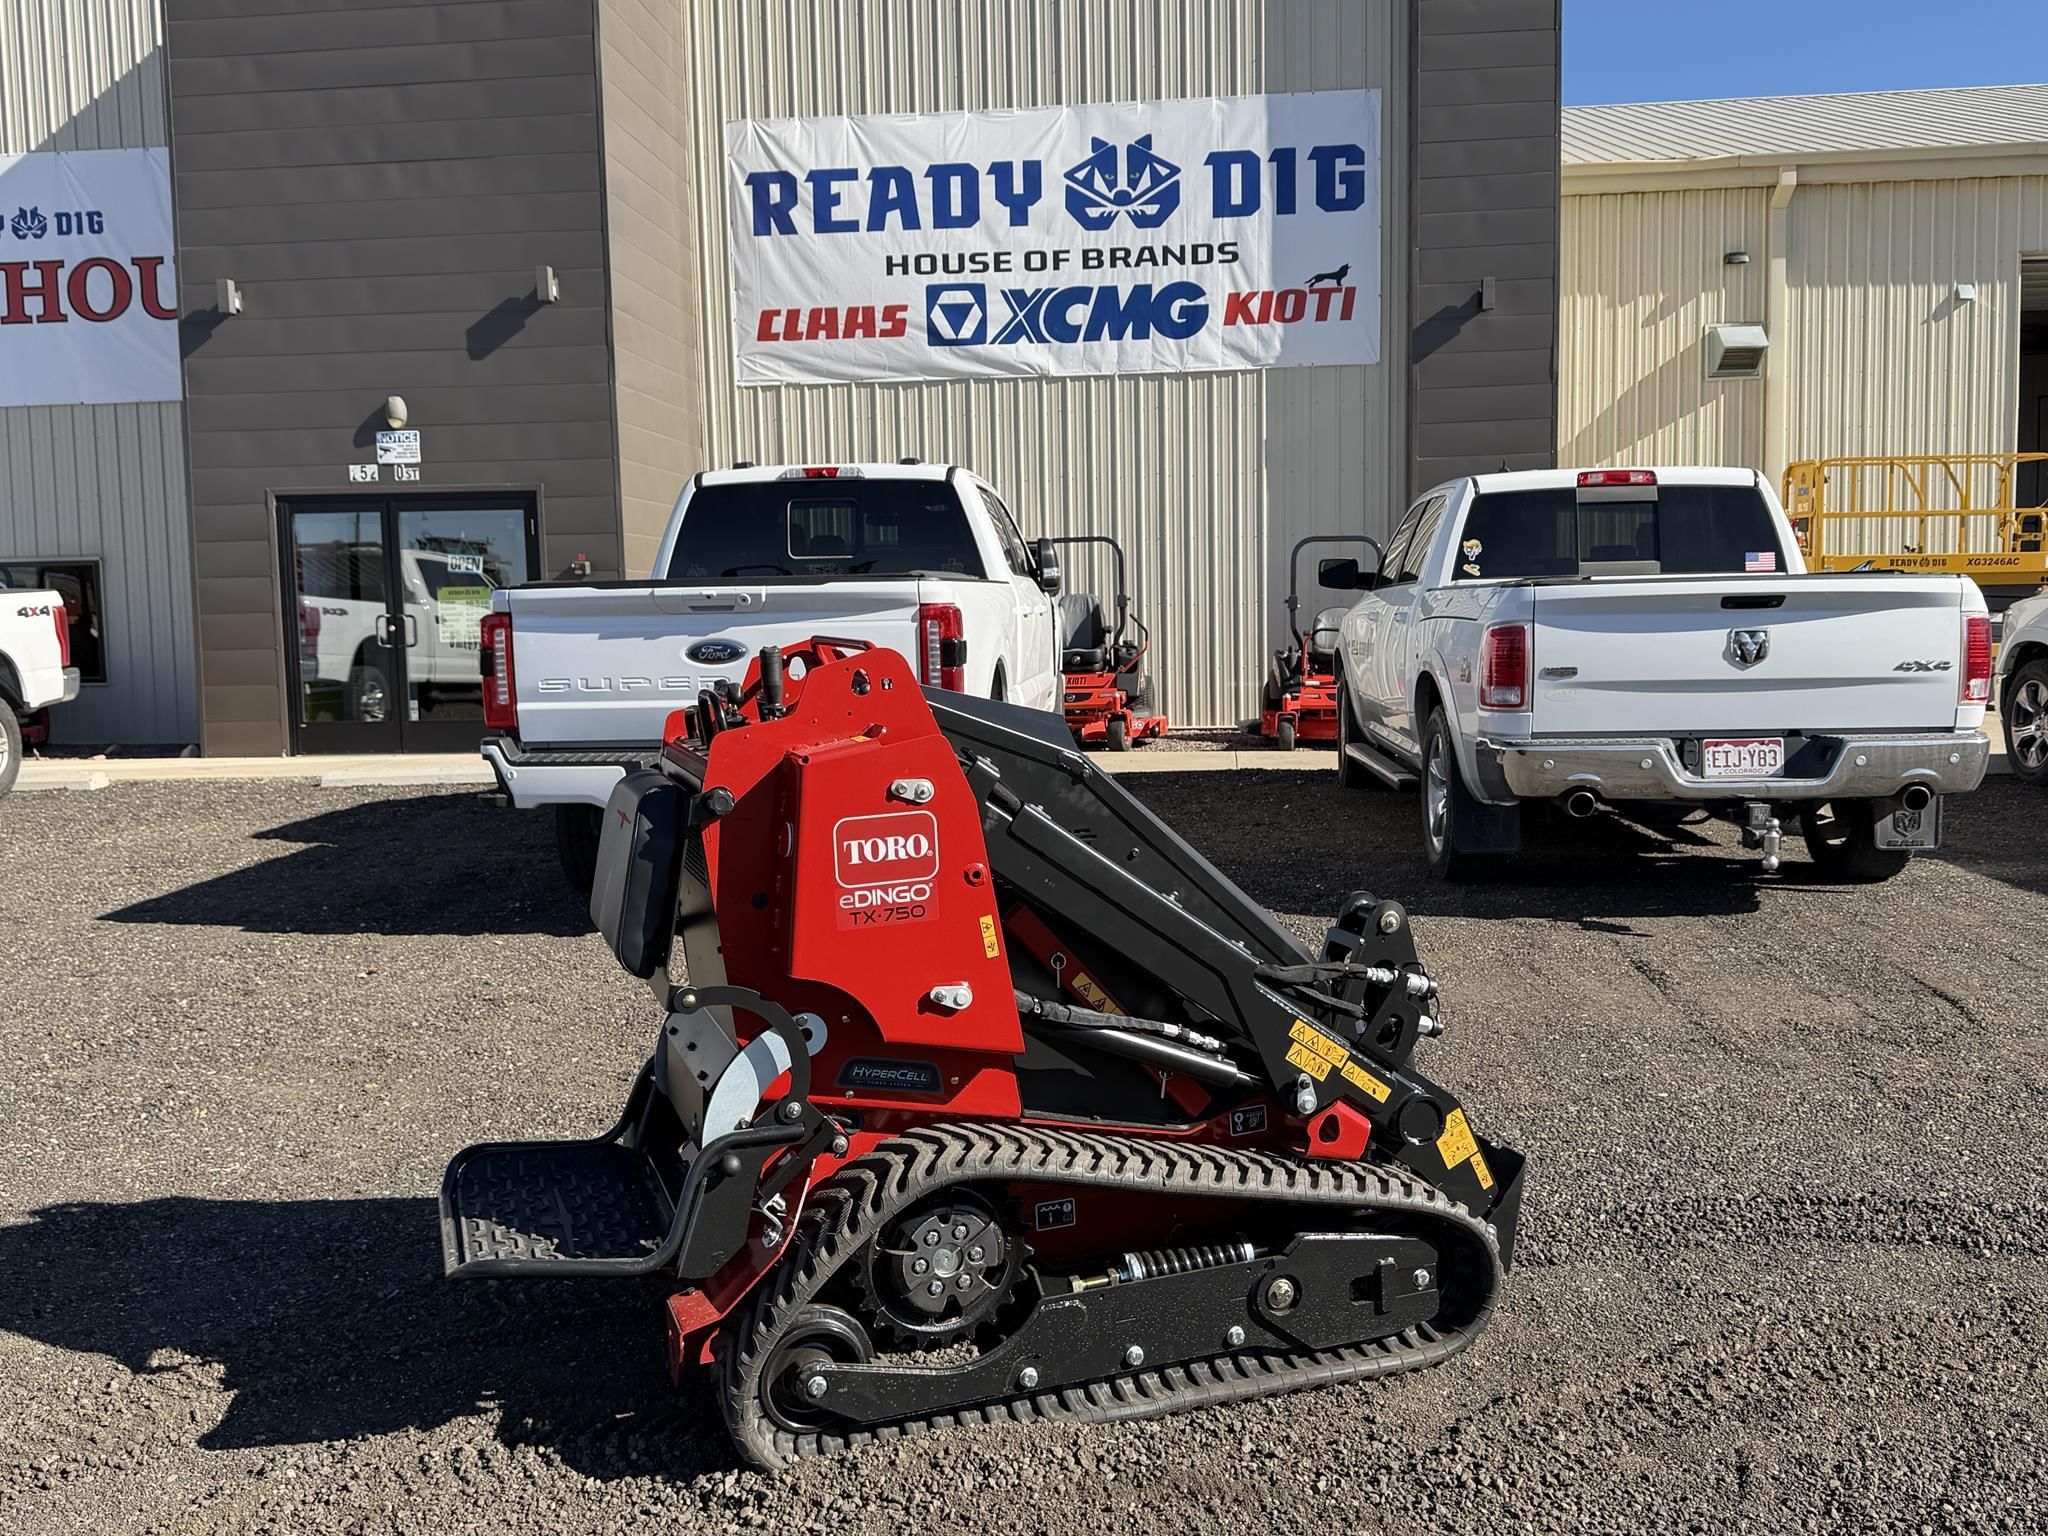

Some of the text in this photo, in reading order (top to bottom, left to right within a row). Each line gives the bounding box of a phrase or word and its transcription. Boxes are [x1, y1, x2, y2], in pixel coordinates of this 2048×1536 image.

[745, 144, 1366, 236] READY DIG
[54, 210, 104, 236] DIG
[886, 241, 1239, 276] HOUSE OF BRANDS
[756, 280, 1357, 344] CLAAS XCMG KIOTI
[377, 432, 417, 442] NOTICE
[450, 556, 480, 570] OPEN
[1889, 558, 1947, 567] READY DIG
[1966, 557, 2020, 567] XG3246AC
[698, 645, 732, 660] Ford
[1067, 677, 1087, 685] KIOTI
[843, 833, 929, 865] TORO
[840, 884, 931, 909] eDINGO
